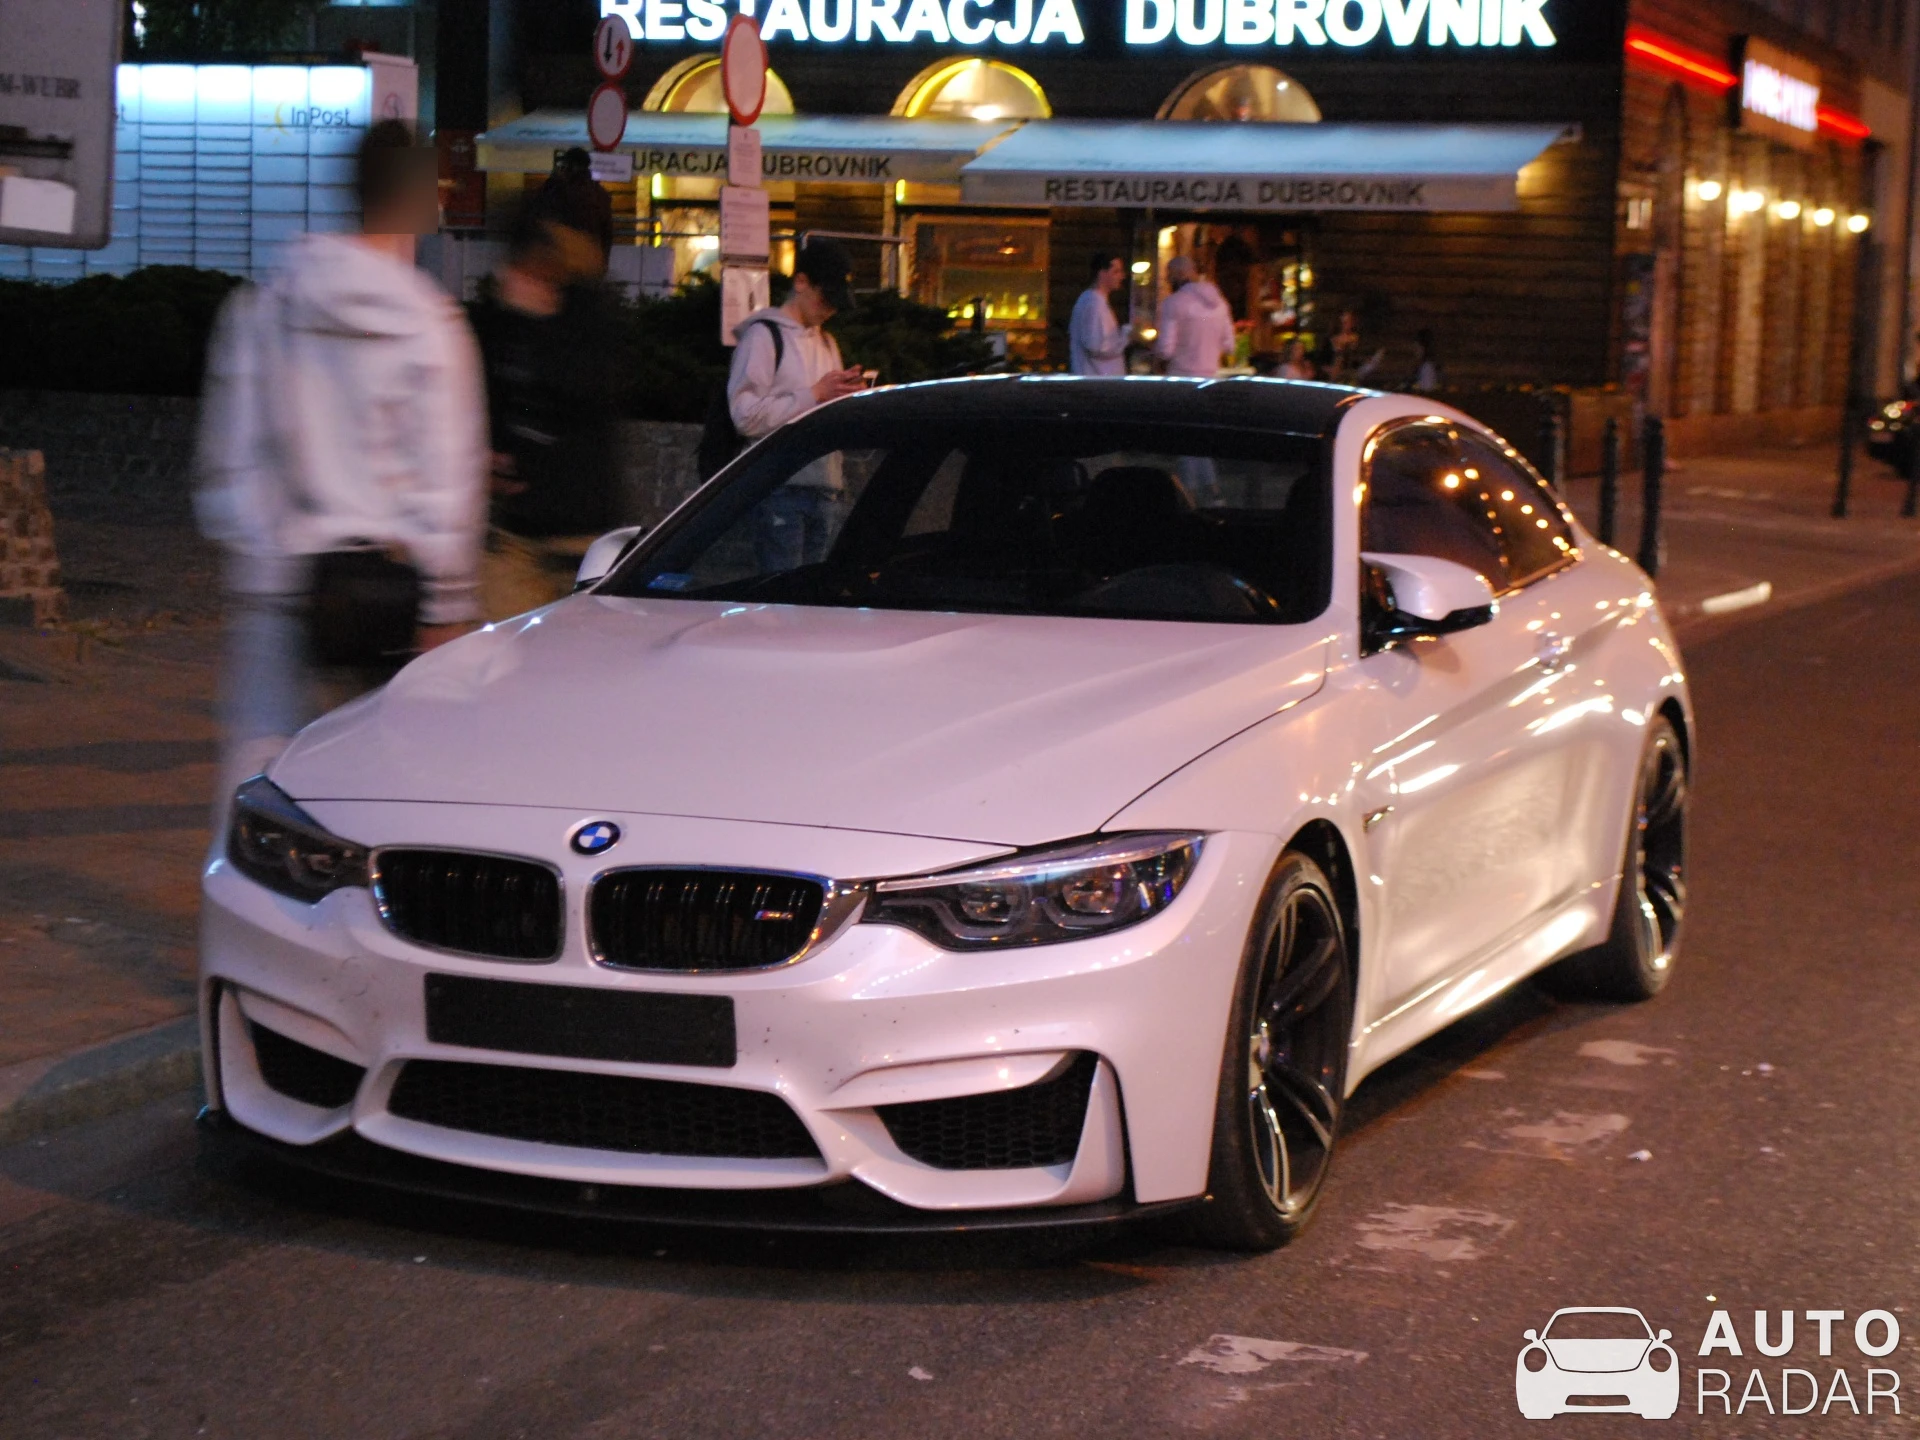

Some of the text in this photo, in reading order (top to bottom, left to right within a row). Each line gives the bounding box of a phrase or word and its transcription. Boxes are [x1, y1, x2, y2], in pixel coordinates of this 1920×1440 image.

[600, 0, 1557, 47] RESAURACJA DUBROVNIK
[291, 106, 350, 126] InPost
[763, 154, 892, 177] UBROVNIK
[1045, 178, 1425, 204] RESTAURACJA DUBROVNIK
